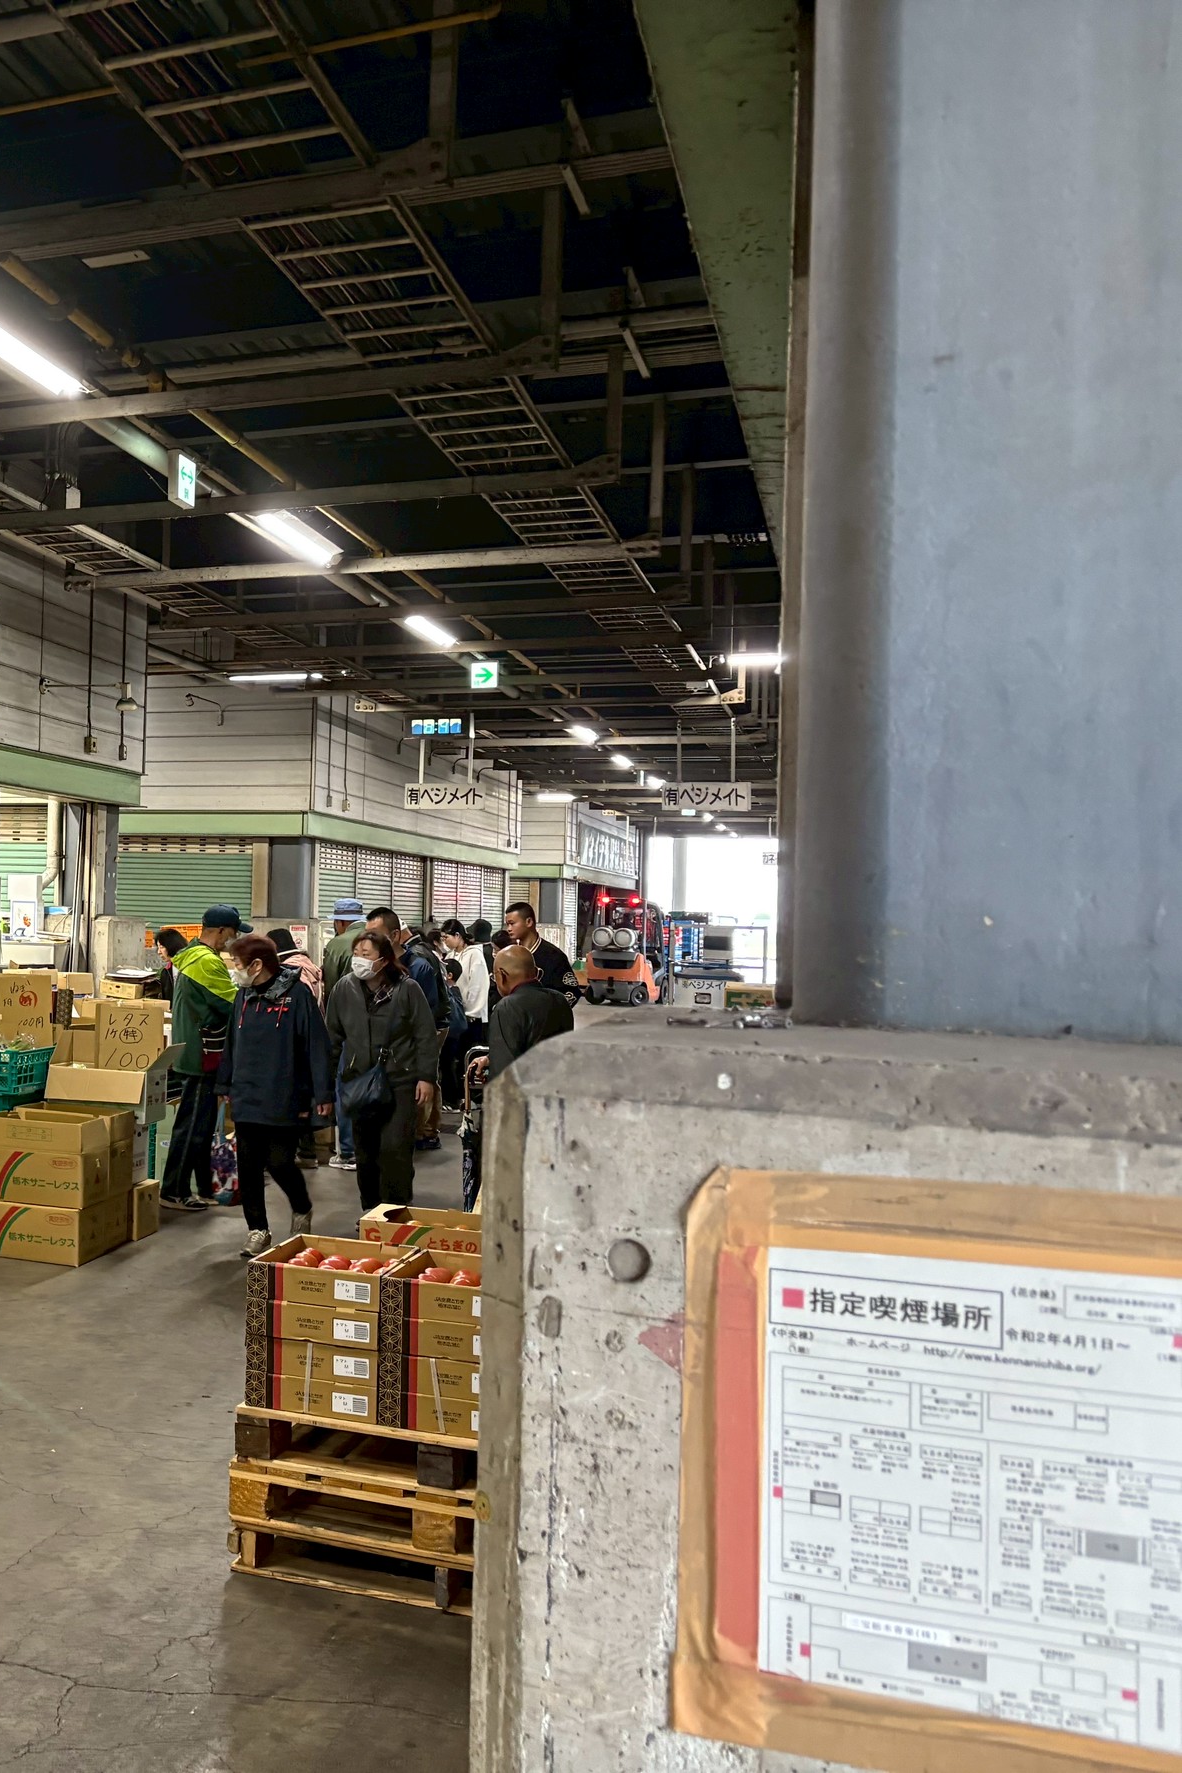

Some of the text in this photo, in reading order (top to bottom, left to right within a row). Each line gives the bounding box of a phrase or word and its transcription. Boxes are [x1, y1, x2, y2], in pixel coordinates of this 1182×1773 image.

[109, 1013, 150, 1026] レタス
[119, 1026, 143, 1044] 特
[105, 1048, 150, 1069] 100
[427, 1237, 477, 1253] とちぎの
[810, 1288, 992, 1331] 指定喫煙場所
